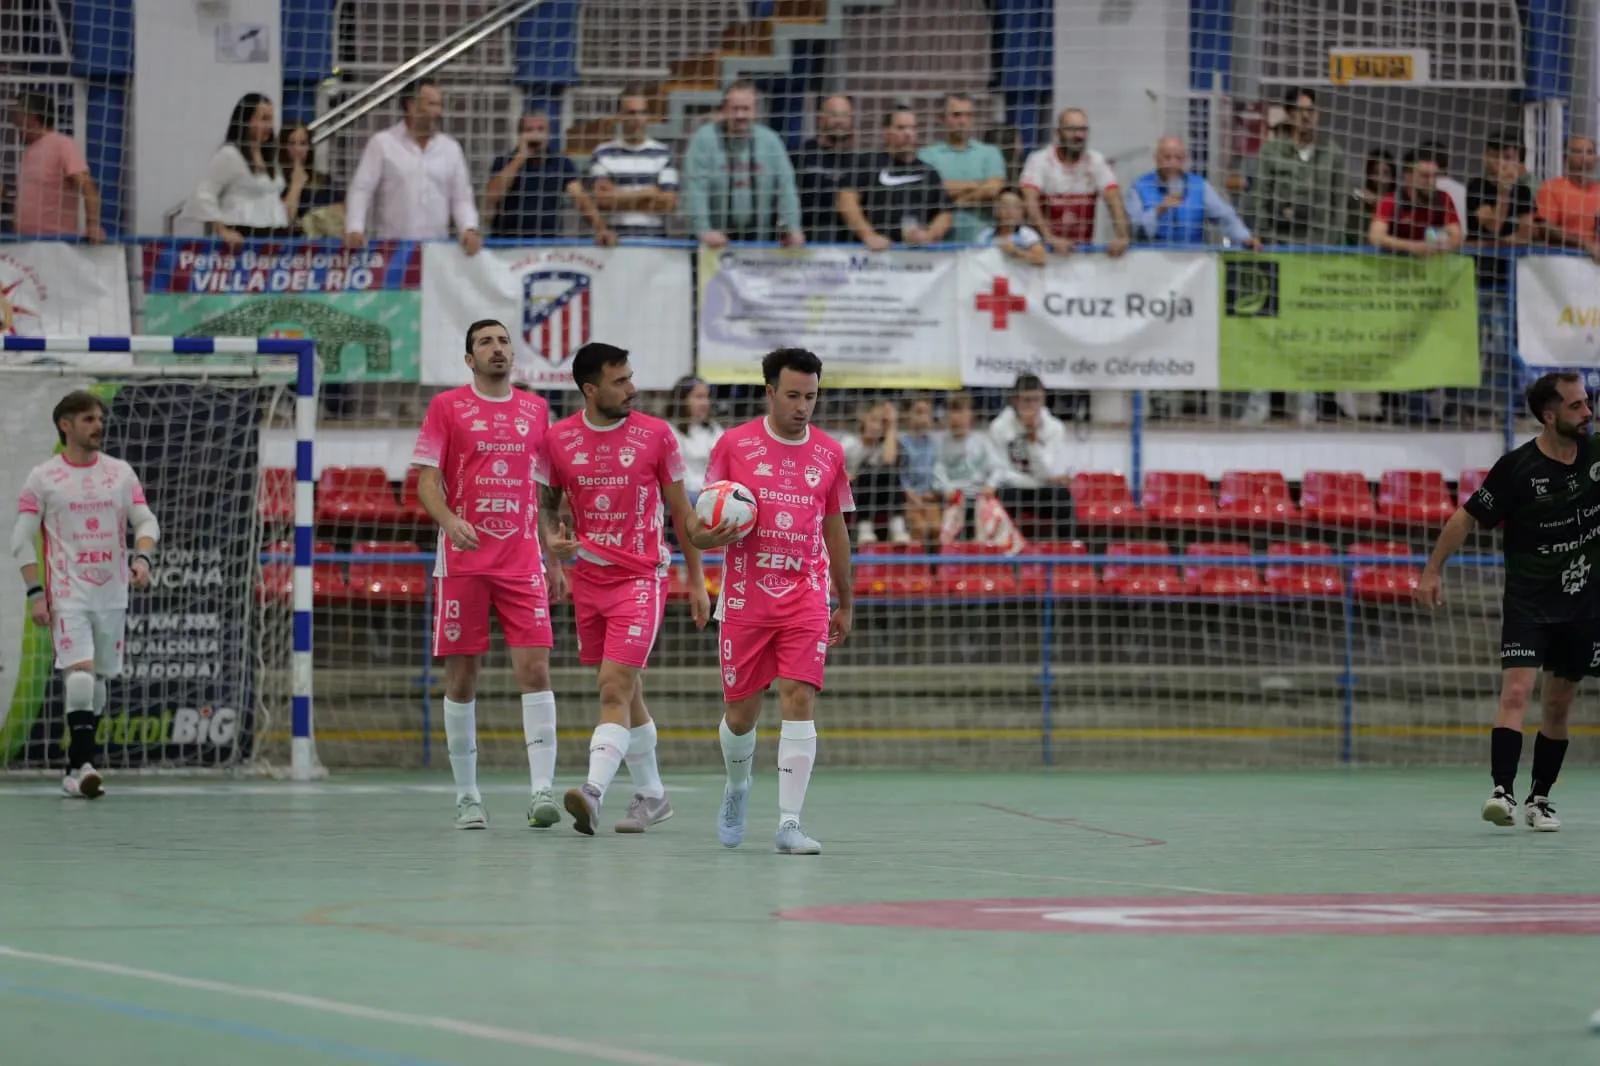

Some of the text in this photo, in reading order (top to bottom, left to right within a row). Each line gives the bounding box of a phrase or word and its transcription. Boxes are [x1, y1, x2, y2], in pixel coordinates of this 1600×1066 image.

[179, 249, 384, 270] Peña Barcelonista
[193, 271, 265, 291] VILLA
[271, 270, 321, 291] DEL
[1043, 290, 1193, 323] Cruz Roja
[974, 356, 1196, 376] Hospital de Córdoba
[477, 441, 525, 452] Beconet
[577, 475, 629, 485] Beconet
[475, 498, 520, 514] ZEN
[758, 487, 815, 506] Beconet
[77, 551, 113, 564] ZEN
[755, 552, 803, 571] ZEN
[445, 599, 460, 619] 13
[724, 639, 732, 660] 9
